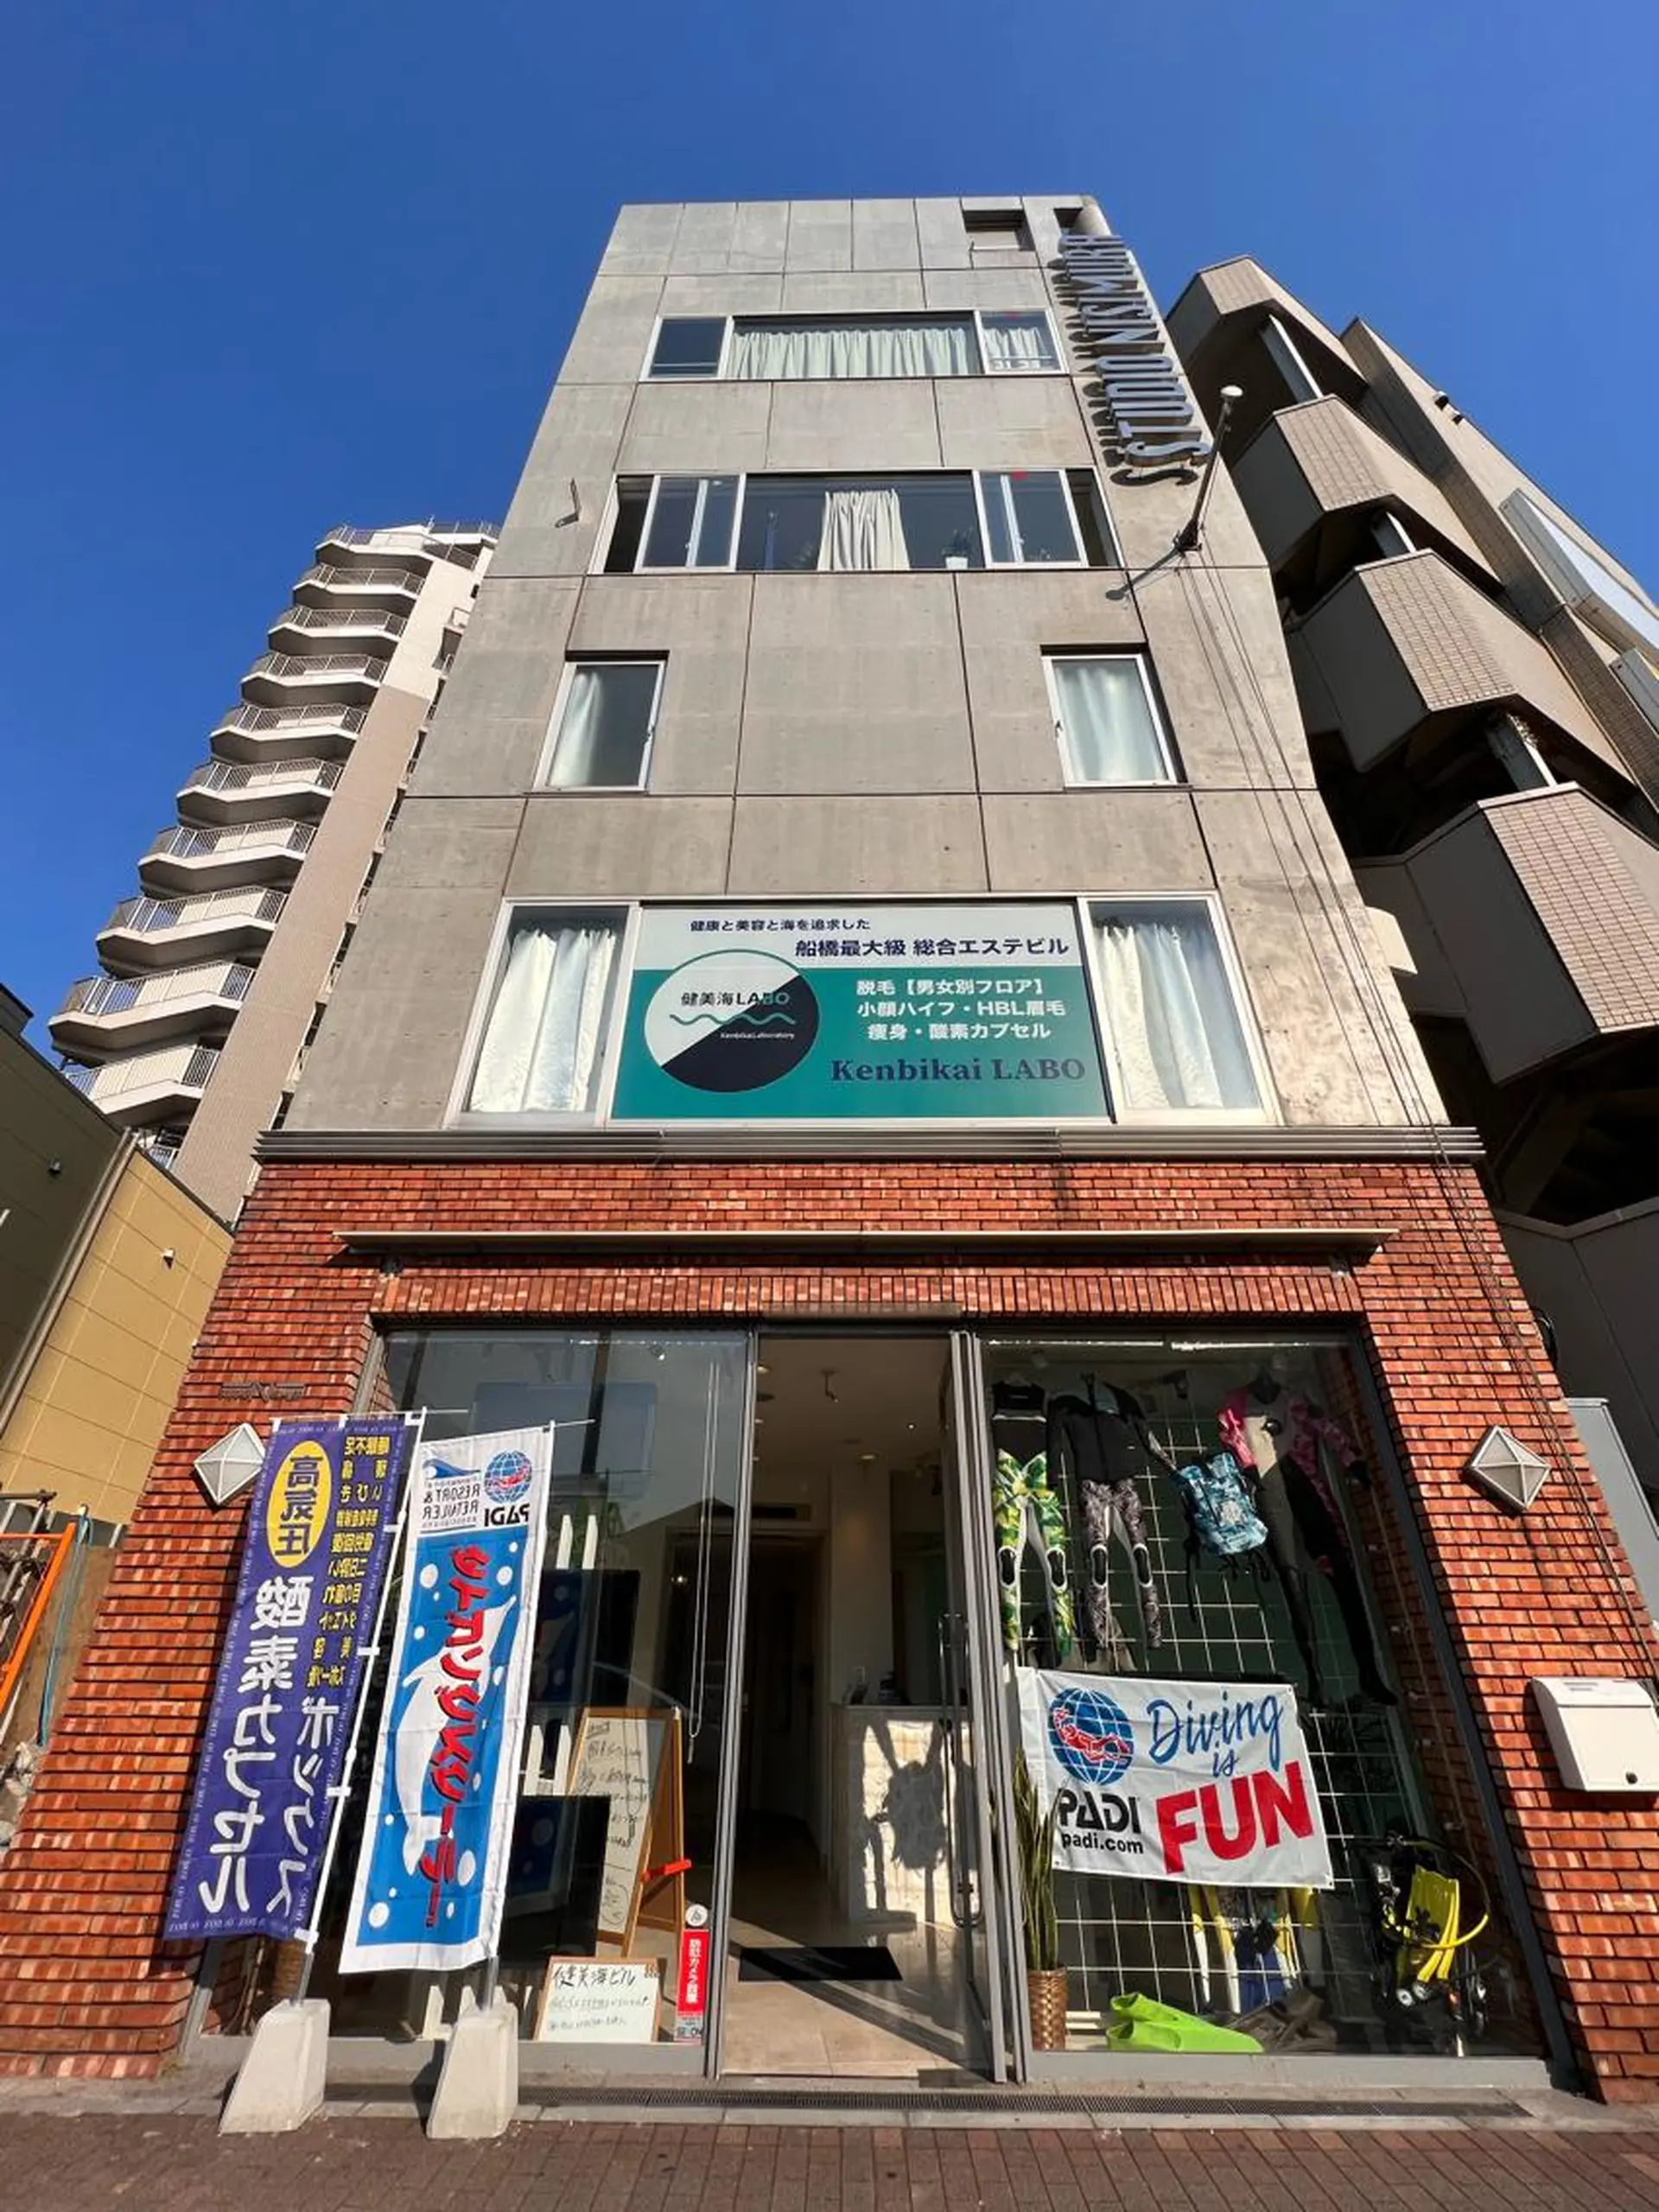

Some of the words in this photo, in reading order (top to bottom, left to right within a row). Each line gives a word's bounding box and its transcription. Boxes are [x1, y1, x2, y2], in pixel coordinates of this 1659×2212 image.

[1058, 234, 1166, 355] NISIMURA
[1095, 354, 1213, 467] STUDIO
[690, 918, 871, 932] 健康と美容と海を追求した
[794, 938, 906, 957] 船橋最大級
[912, 938, 1070, 957] 総合エステビル
[681, 991, 790, 1007] 健美海LABO
[830, 1058, 981, 1082] Kenbikai
[993, 1058, 1086, 1081] LABO
[1146, 1691, 1285, 1773] Diving
[1212, 1744, 1241, 1778] is
[1056, 1787, 1142, 1834] PADI
[1155, 1760, 1314, 1875] FUN
[1061, 1831, 1145, 1855] padi.com
